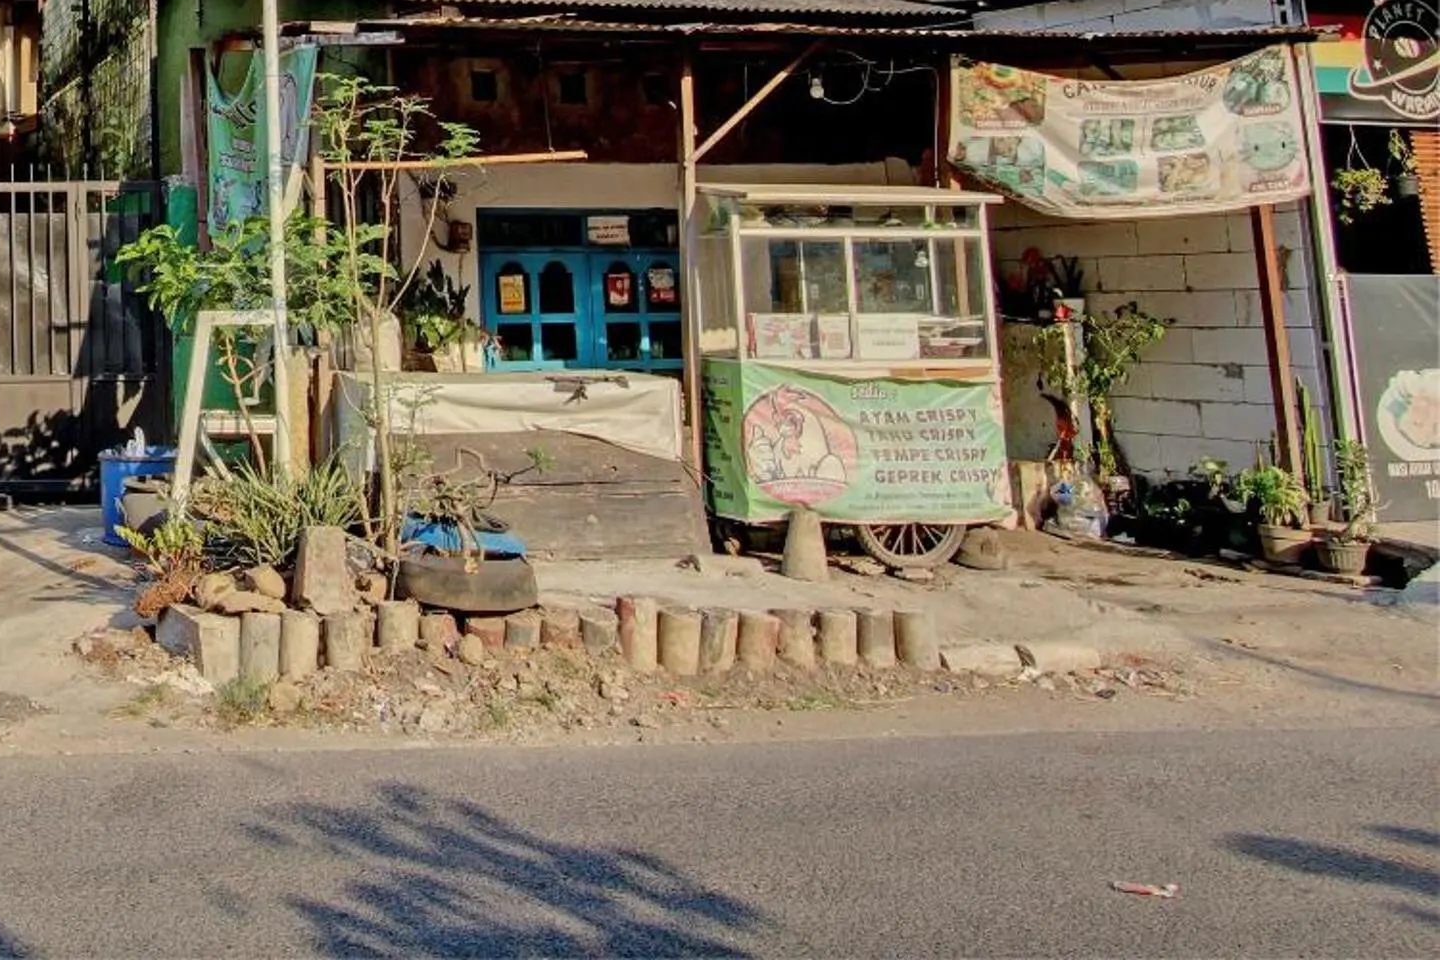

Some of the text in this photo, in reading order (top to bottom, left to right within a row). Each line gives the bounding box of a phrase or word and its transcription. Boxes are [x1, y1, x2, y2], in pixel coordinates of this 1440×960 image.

[1368, 3, 1425, 40] PLANET
[860, 408, 977, 424] AYAM CRISPY
[919, 427, 975, 441] CRISPY
[873, 448, 988, 462] TEMPE CRISPY
[874, 468, 998, 484] GEPREK CRISPY
